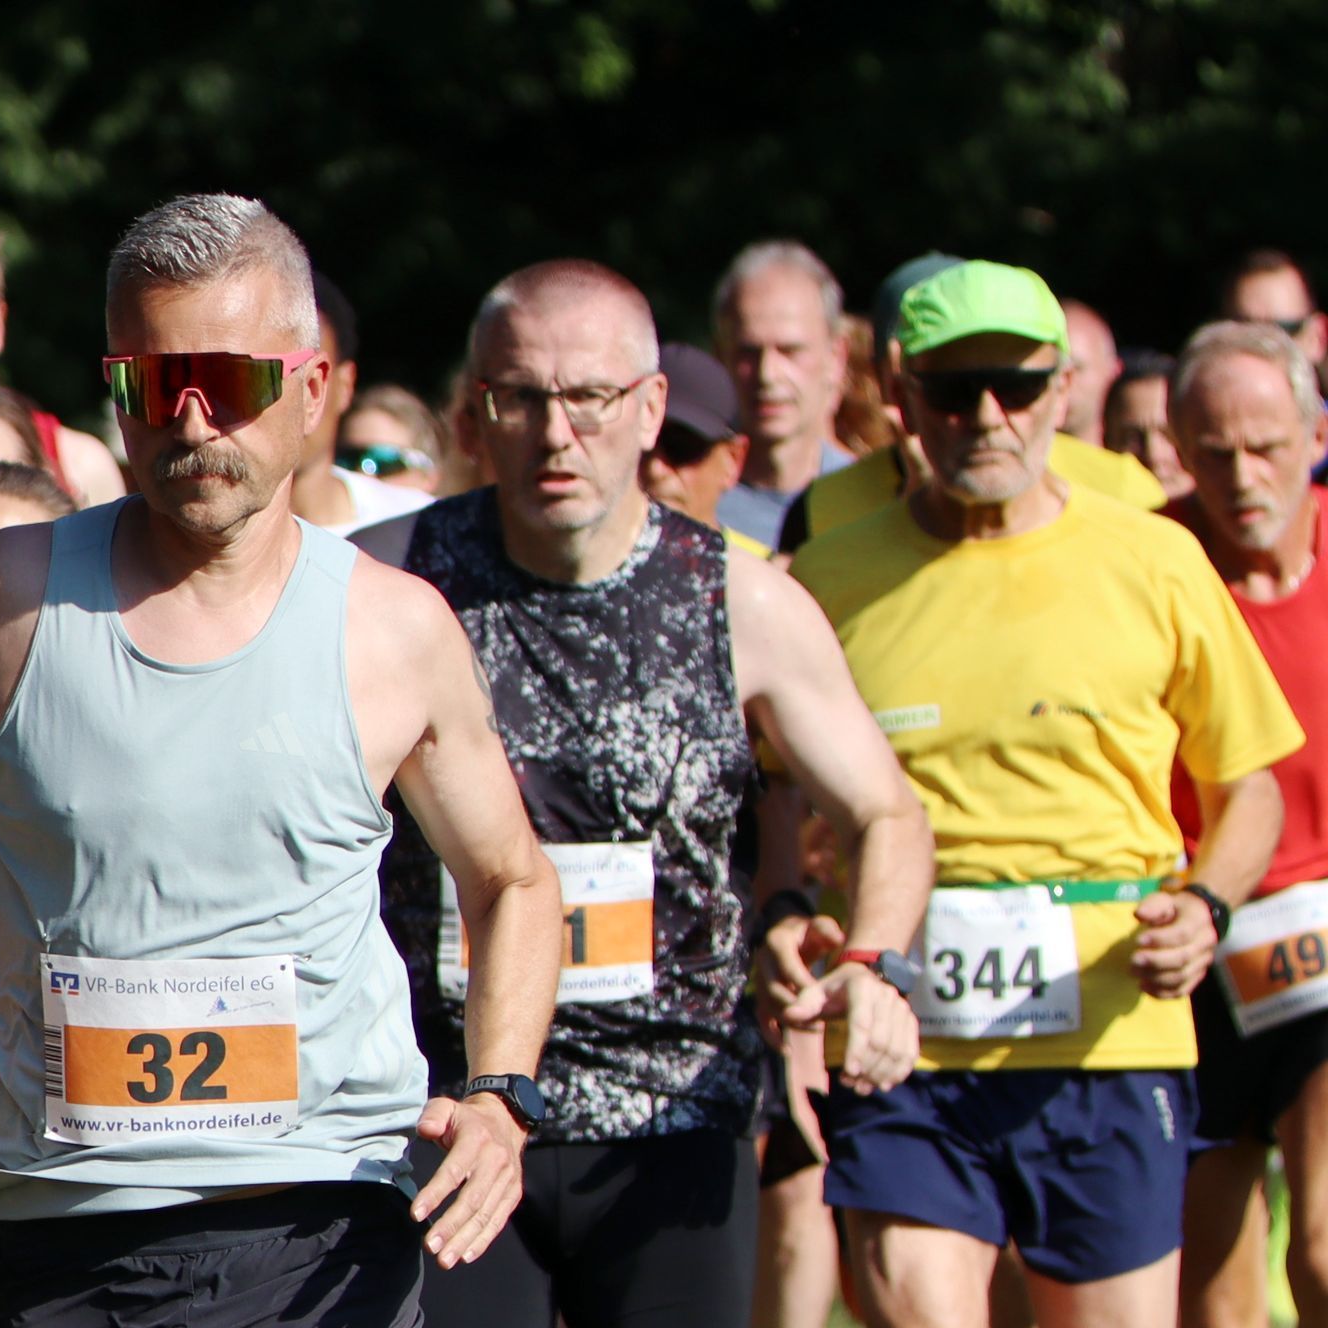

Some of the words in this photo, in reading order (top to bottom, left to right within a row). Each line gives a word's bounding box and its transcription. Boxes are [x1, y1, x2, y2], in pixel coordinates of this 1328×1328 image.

[84, 976, 159, 995] VR-Bank
[164, 975, 245, 994] Nordeifel
[250, 975, 275, 991] eG
[933, 945, 1049, 1002] 344
[1268, 932, 1326, 986] 49
[126, 1030, 228, 1104] 32
[60, 1112, 282, 1133] www.vr-banknordeifel.de
